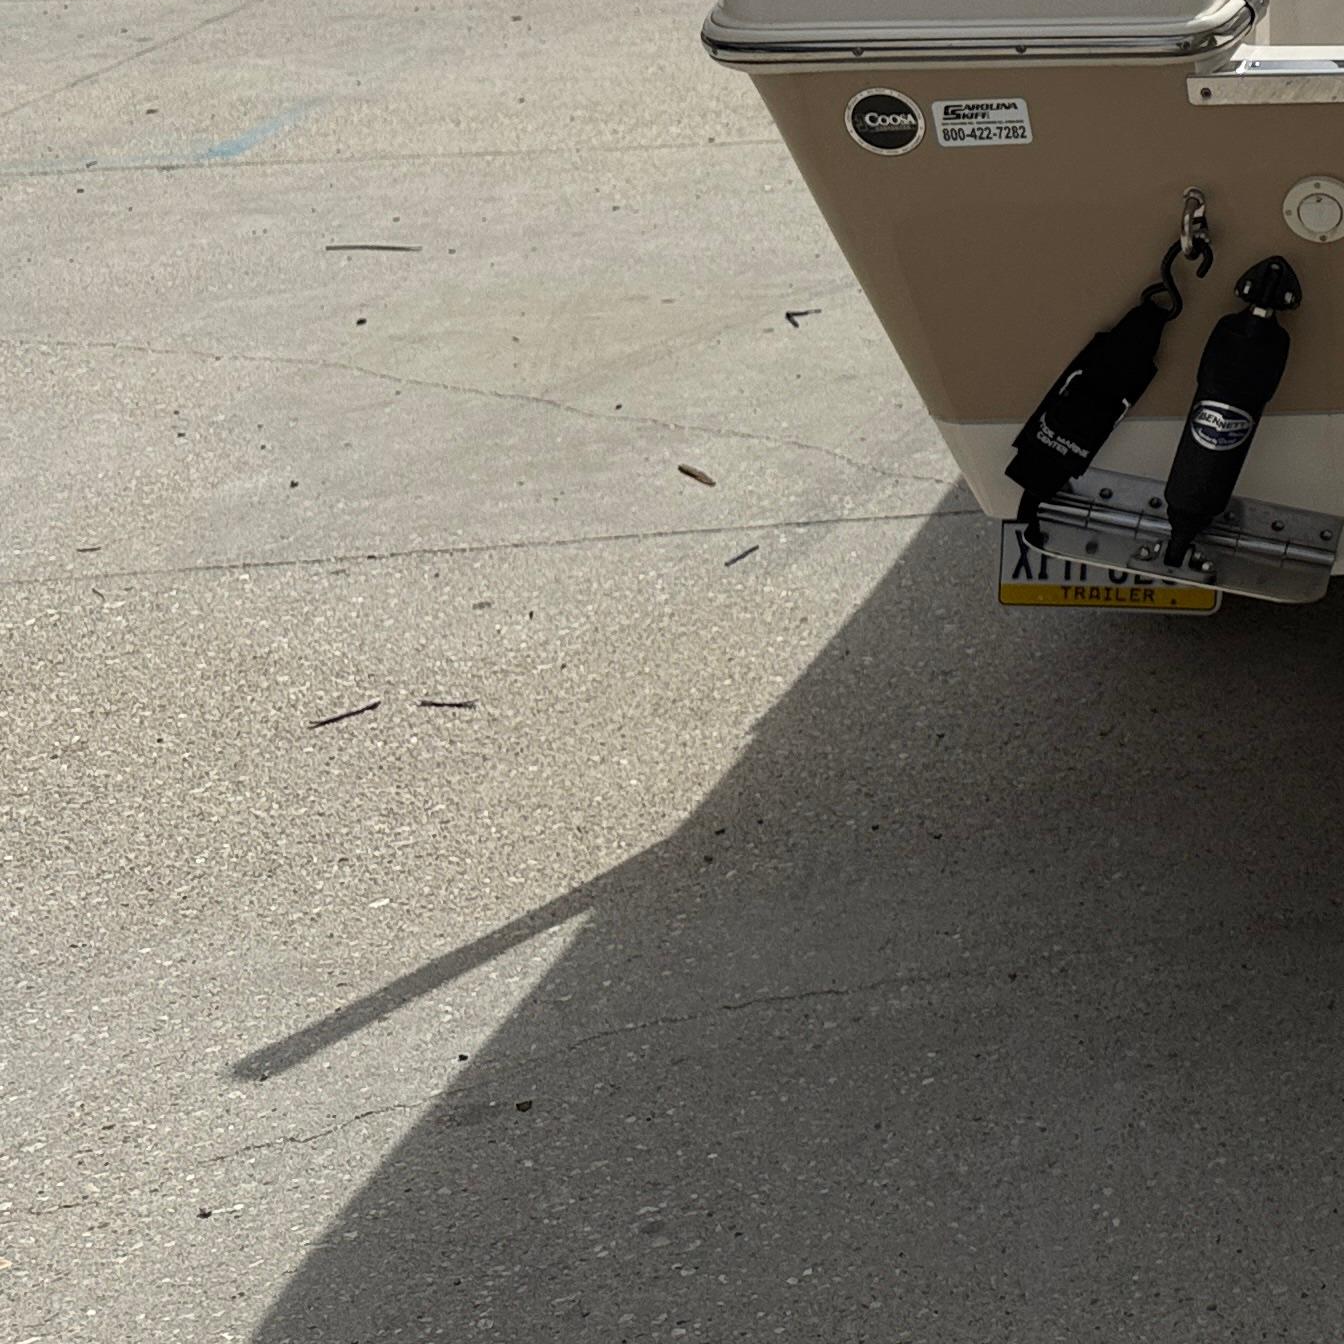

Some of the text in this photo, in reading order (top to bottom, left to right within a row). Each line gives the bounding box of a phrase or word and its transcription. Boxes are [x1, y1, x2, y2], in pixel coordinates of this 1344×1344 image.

[944, 102, 1019, 116] CAROLINA
[864, 111, 917, 127] COOSA
[942, 125, 1028, 142] 800-422-7282
[1198, 411, 1248, 430] BENNETT
[1060, 585, 1156, 603] TRAILER
